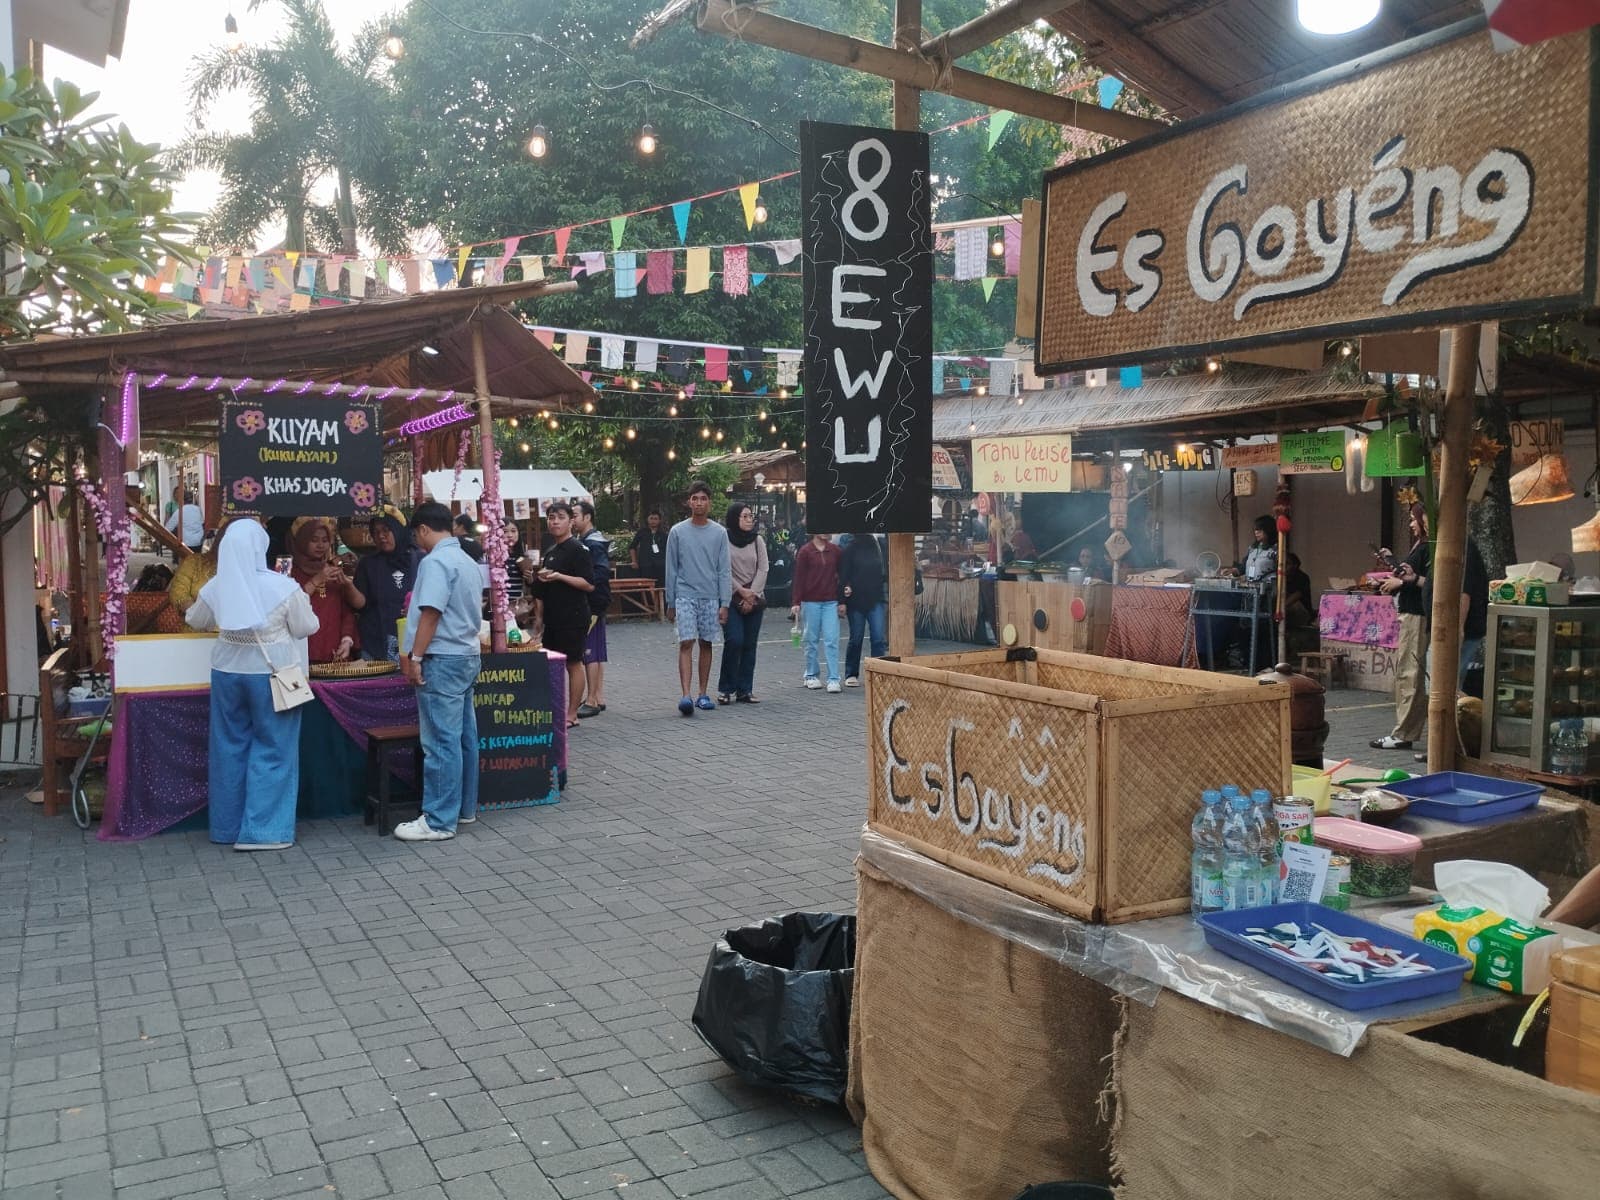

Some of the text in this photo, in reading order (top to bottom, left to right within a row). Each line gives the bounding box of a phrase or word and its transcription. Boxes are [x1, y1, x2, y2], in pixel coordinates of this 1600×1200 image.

[1076, 134, 1535, 321] Es Goyéng
[831, 138, 893, 464] 8 EWU
[267, 417, 340, 446] KUYAM
[977, 442, 1020, 462] Tahu
[1284, 438, 1305, 450] TAHU
[1015, 466, 1058, 483] Lemu
[264, 476, 347, 496] KHAS JOGJA
[494, 709, 505, 723] DI
[882, 698, 945, 820] Es
[1292, 812, 1309, 821] SAPI
